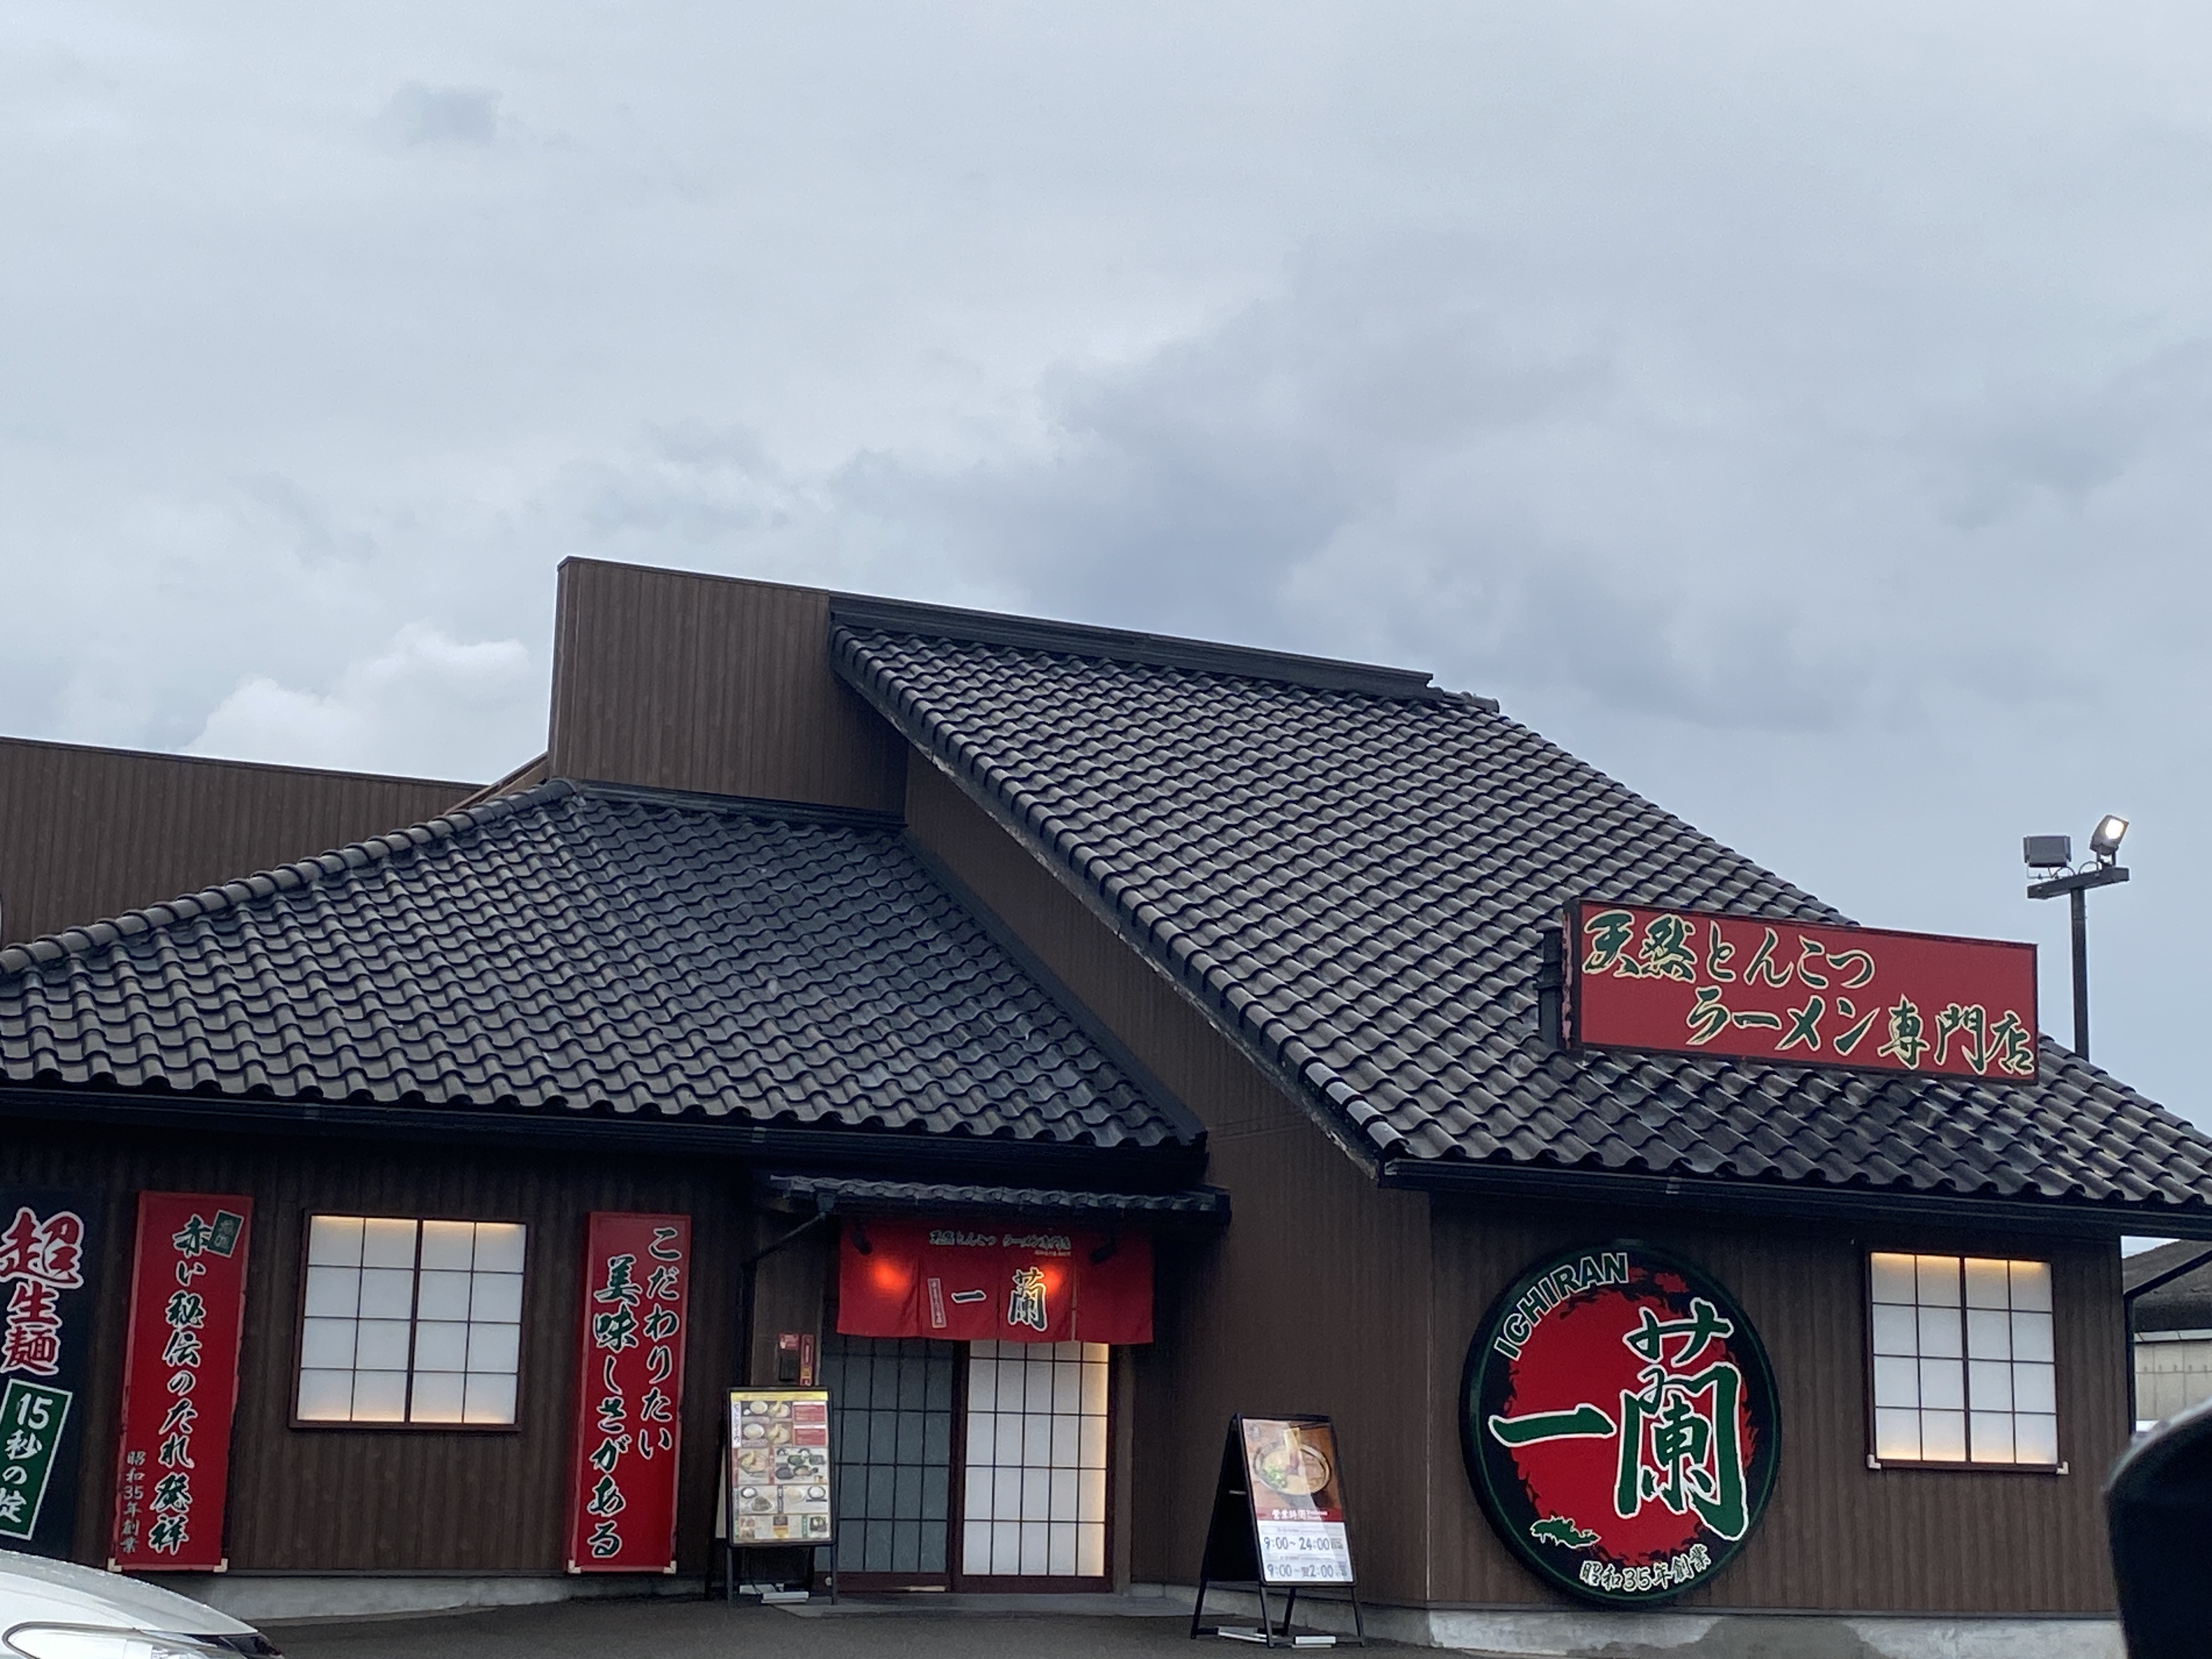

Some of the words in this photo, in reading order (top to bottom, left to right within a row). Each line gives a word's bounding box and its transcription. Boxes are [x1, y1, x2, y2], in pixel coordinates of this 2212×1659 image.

[1582, 910, 1875, 989] 天然とんこつ
[1685, 987, 2035, 1076] ラーメン専門店
[0, 1207, 84, 1375] 超生麺
[638, 1227, 680, 1459] こだわりたい
[1494, 1253, 1628, 1361] ICHIRAN
[588, 1254, 642, 1559] 美味しさがある
[1488, 1297, 1748, 1541] 一蘭
[120, 1451, 146, 1554] 昭和35年創業
[1579, 1544, 1711, 1592] 昭和35年創業
